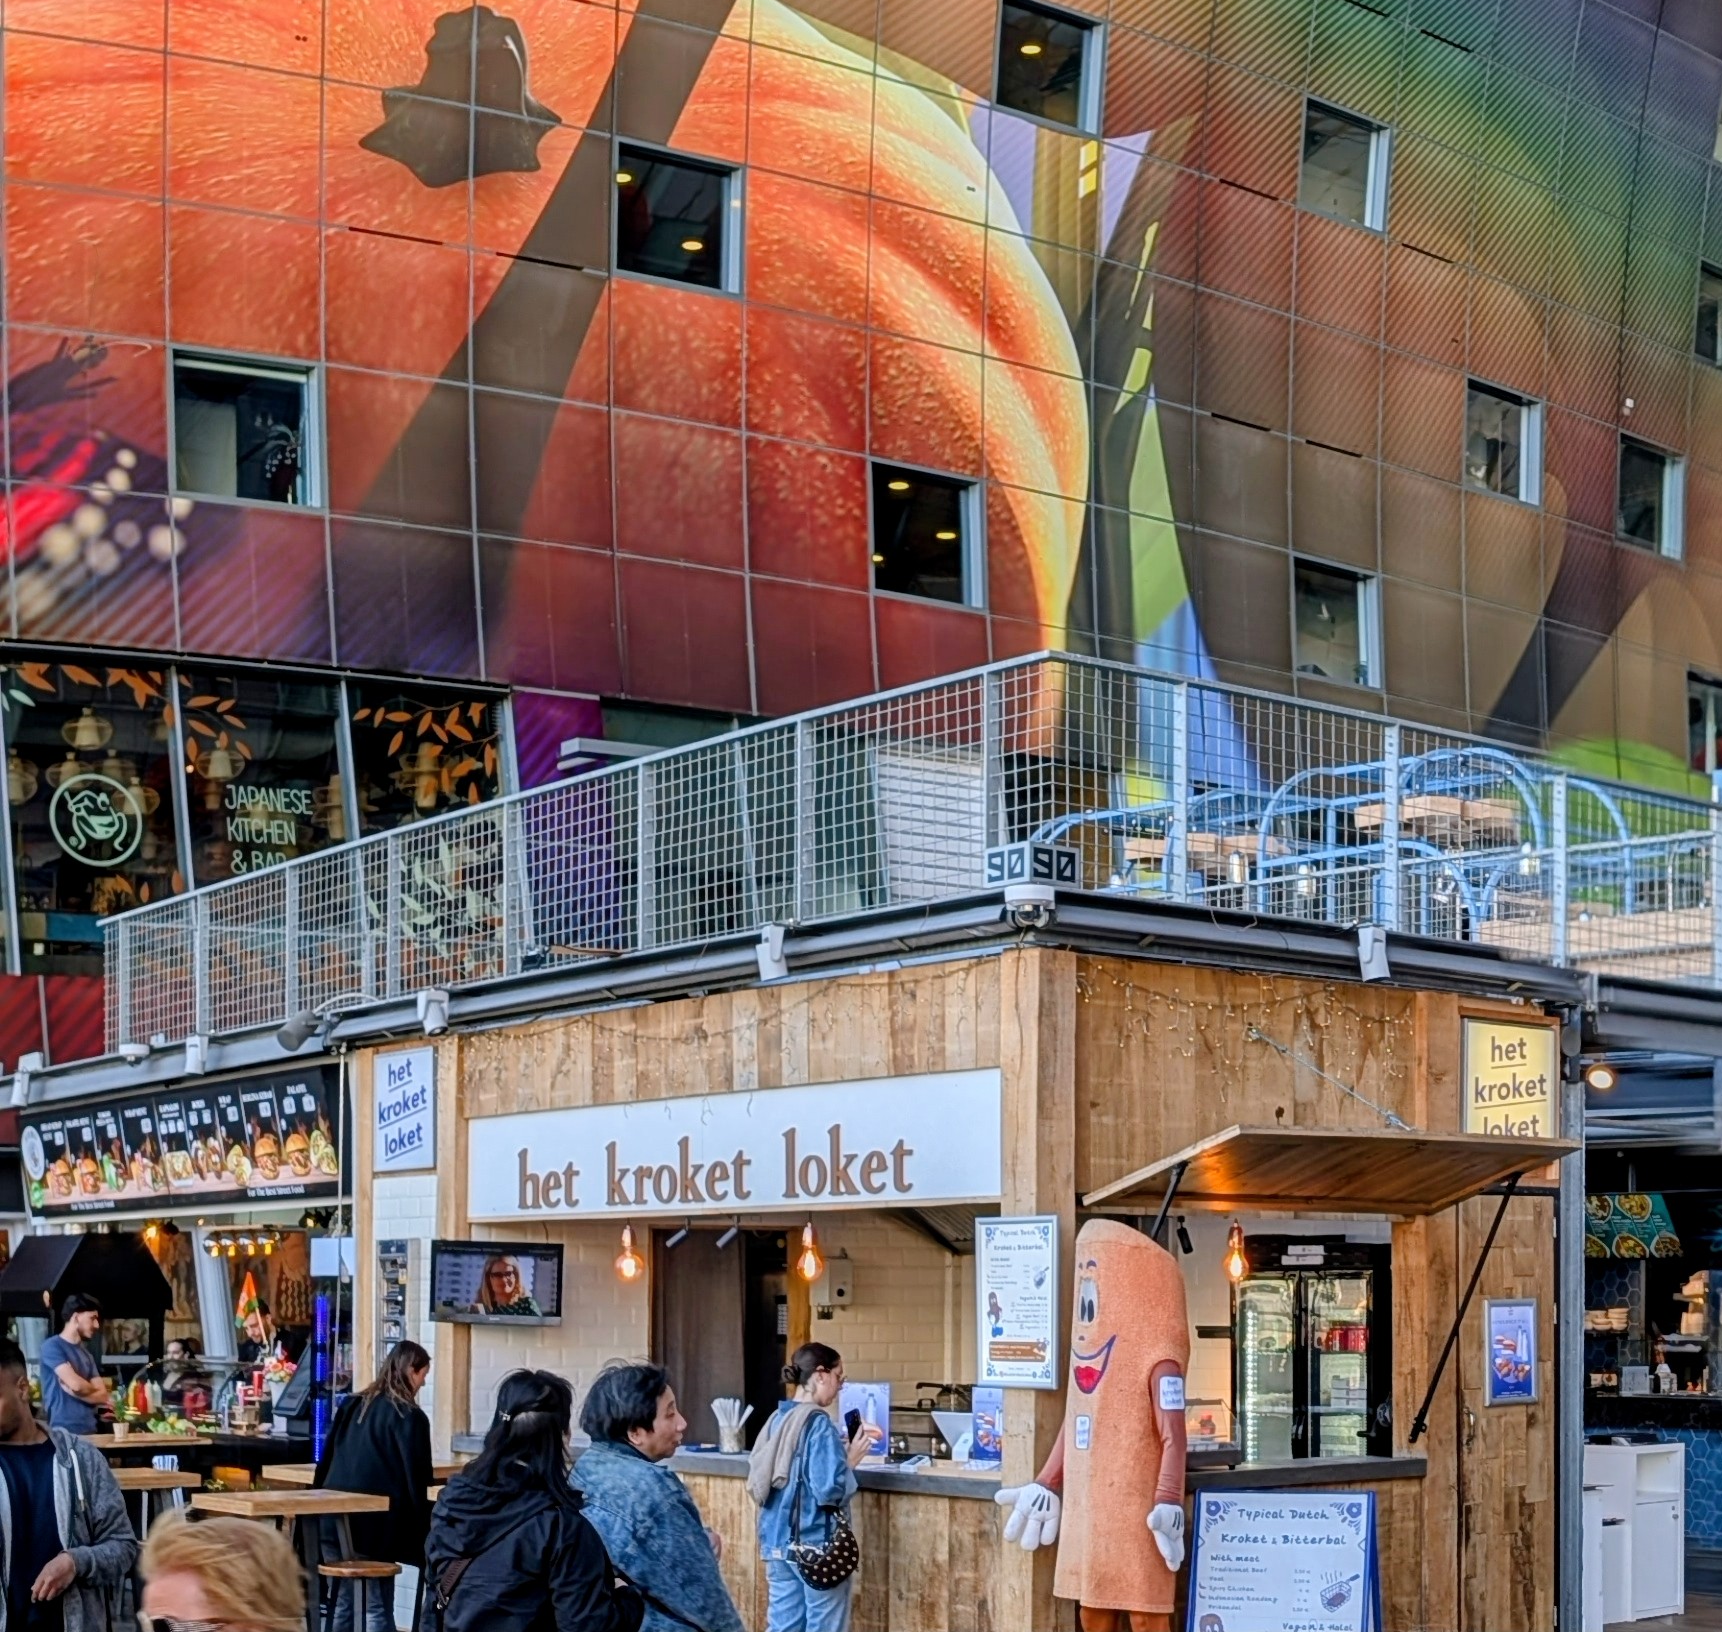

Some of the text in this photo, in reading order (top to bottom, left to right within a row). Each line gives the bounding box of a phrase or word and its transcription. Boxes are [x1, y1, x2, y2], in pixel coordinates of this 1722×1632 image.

[225, 784, 313, 815] JAPANESE
[228, 817, 297, 846] KITCHEN
[230, 850, 248, 875] &
[988, 847, 1024, 883] 90
[1033, 847, 1076, 883] 90
[1491, 1036, 1527, 1062] het
[387, 1056, 414, 1086] het
[1475, 1072, 1547, 1103] kroket
[378, 1085, 427, 1123] kroket
[384, 1121, 423, 1157] loket
[1484, 1114, 1540, 1138] loket
[518, 1124, 914, 1210] het kroket loket
[1237, 1509, 1330, 1521] Typical Dutch
[1221, 1534, 1268, 1544] Kroket
[1282, 1534, 1347, 1545] Bitterbal
